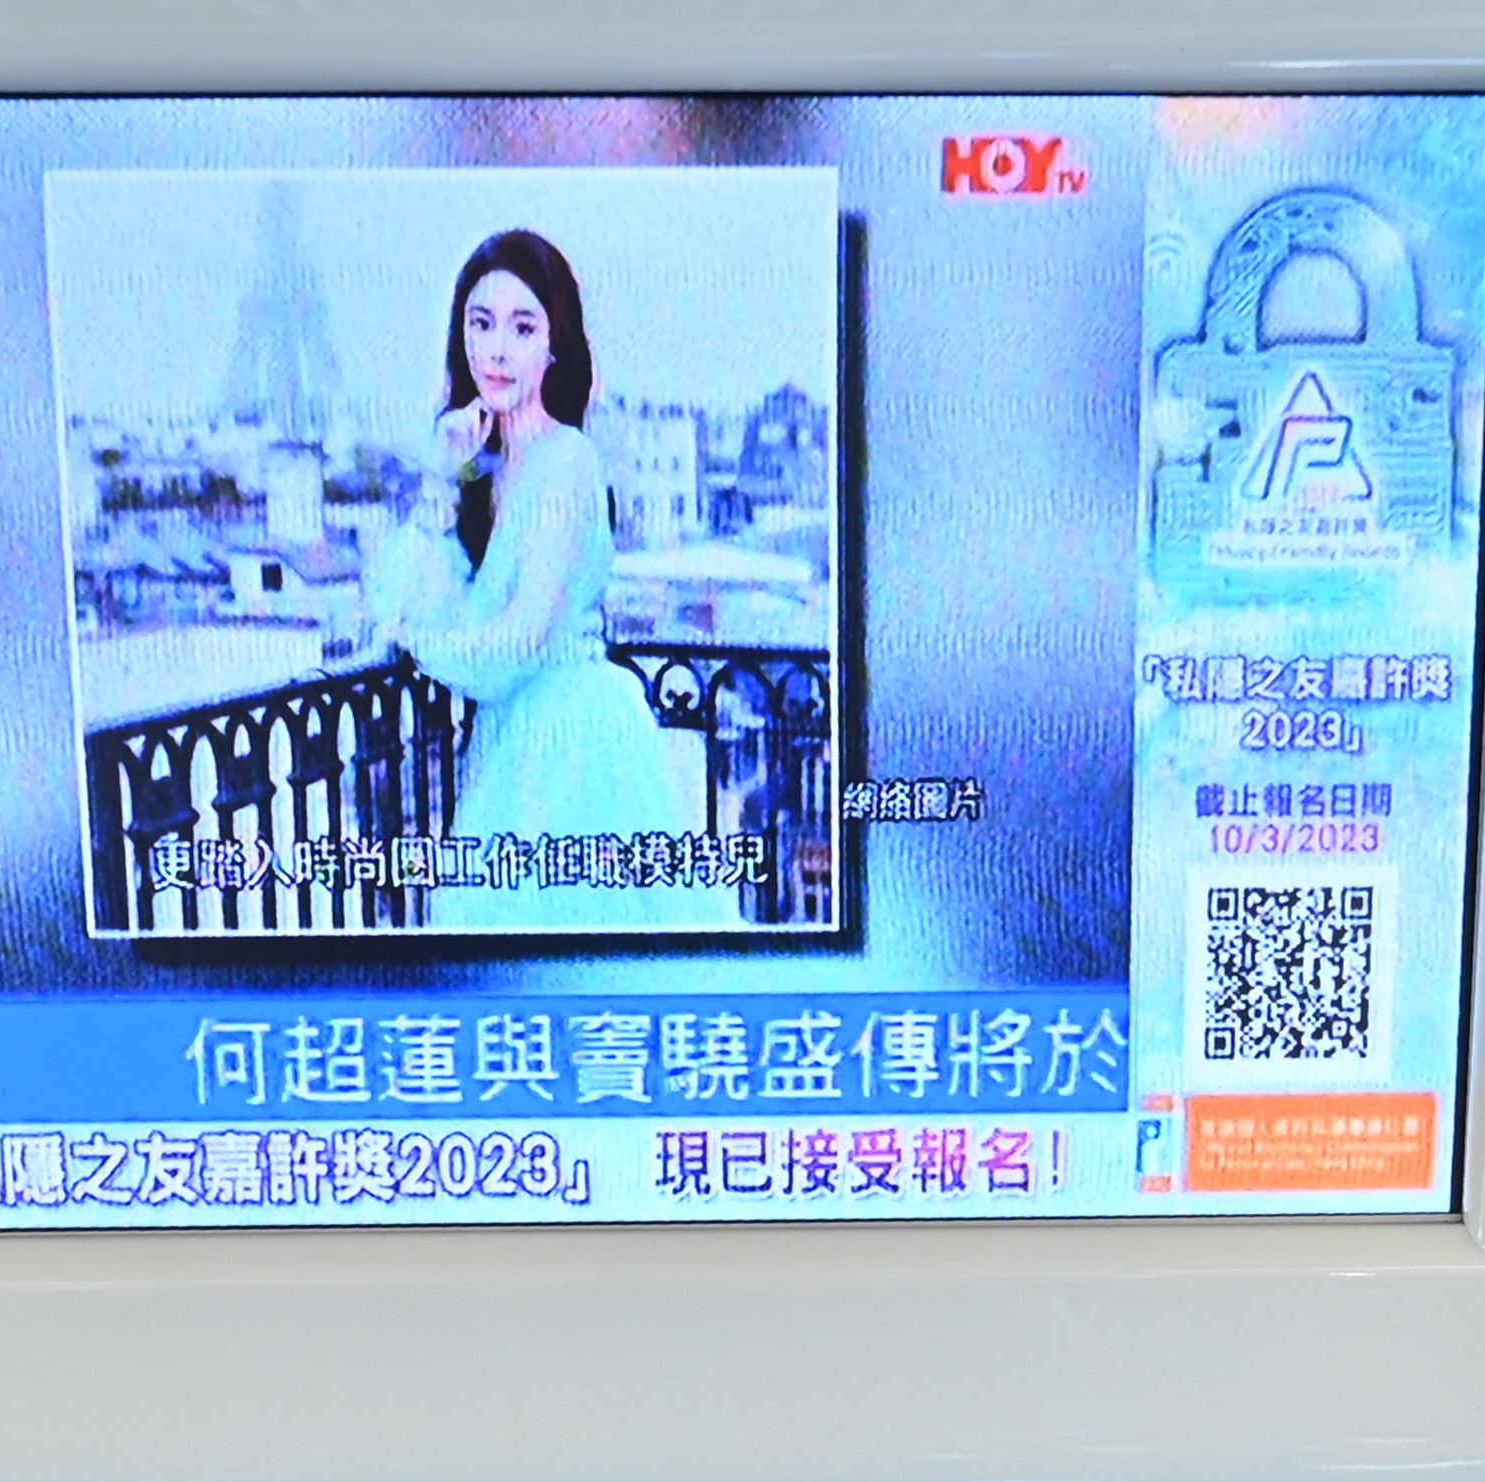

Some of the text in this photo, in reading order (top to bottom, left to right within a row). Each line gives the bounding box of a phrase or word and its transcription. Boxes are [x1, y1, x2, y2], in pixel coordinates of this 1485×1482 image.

[941, 137, 1085, 193] HOY TV
[842, 780, 984, 820] 網絡圖片
[1195, 783, 1392, 818] 截止報名日期
[150, 831, 770, 889] 更踏入時尚圈工作任職模特兒
[1211, 823, 1380, 854] 10/3/2023
[185, 1010, 1128, 1105] 何超蓮與竇驍盛傳將於
